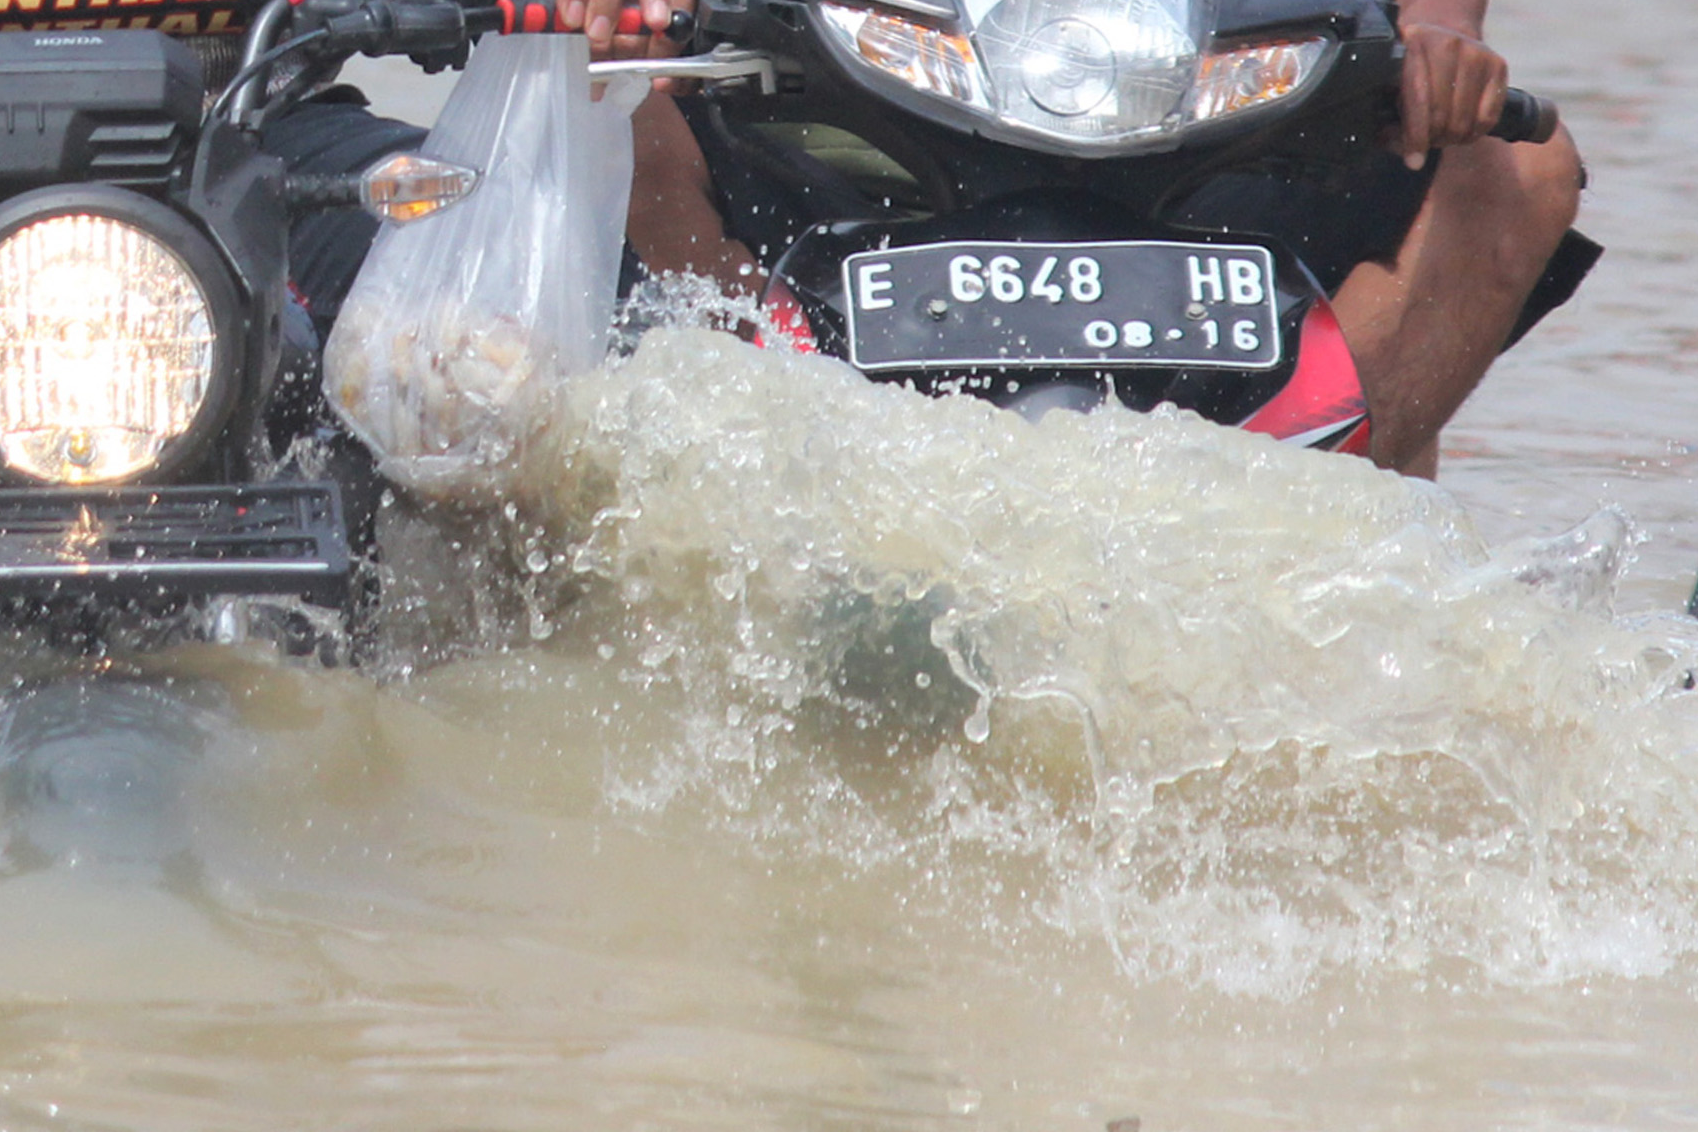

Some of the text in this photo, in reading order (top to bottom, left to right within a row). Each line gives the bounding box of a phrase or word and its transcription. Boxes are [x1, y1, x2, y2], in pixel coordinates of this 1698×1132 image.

[34, 36, 104, 47] HONDA
[860, 255, 1264, 310] E 6648 HB
